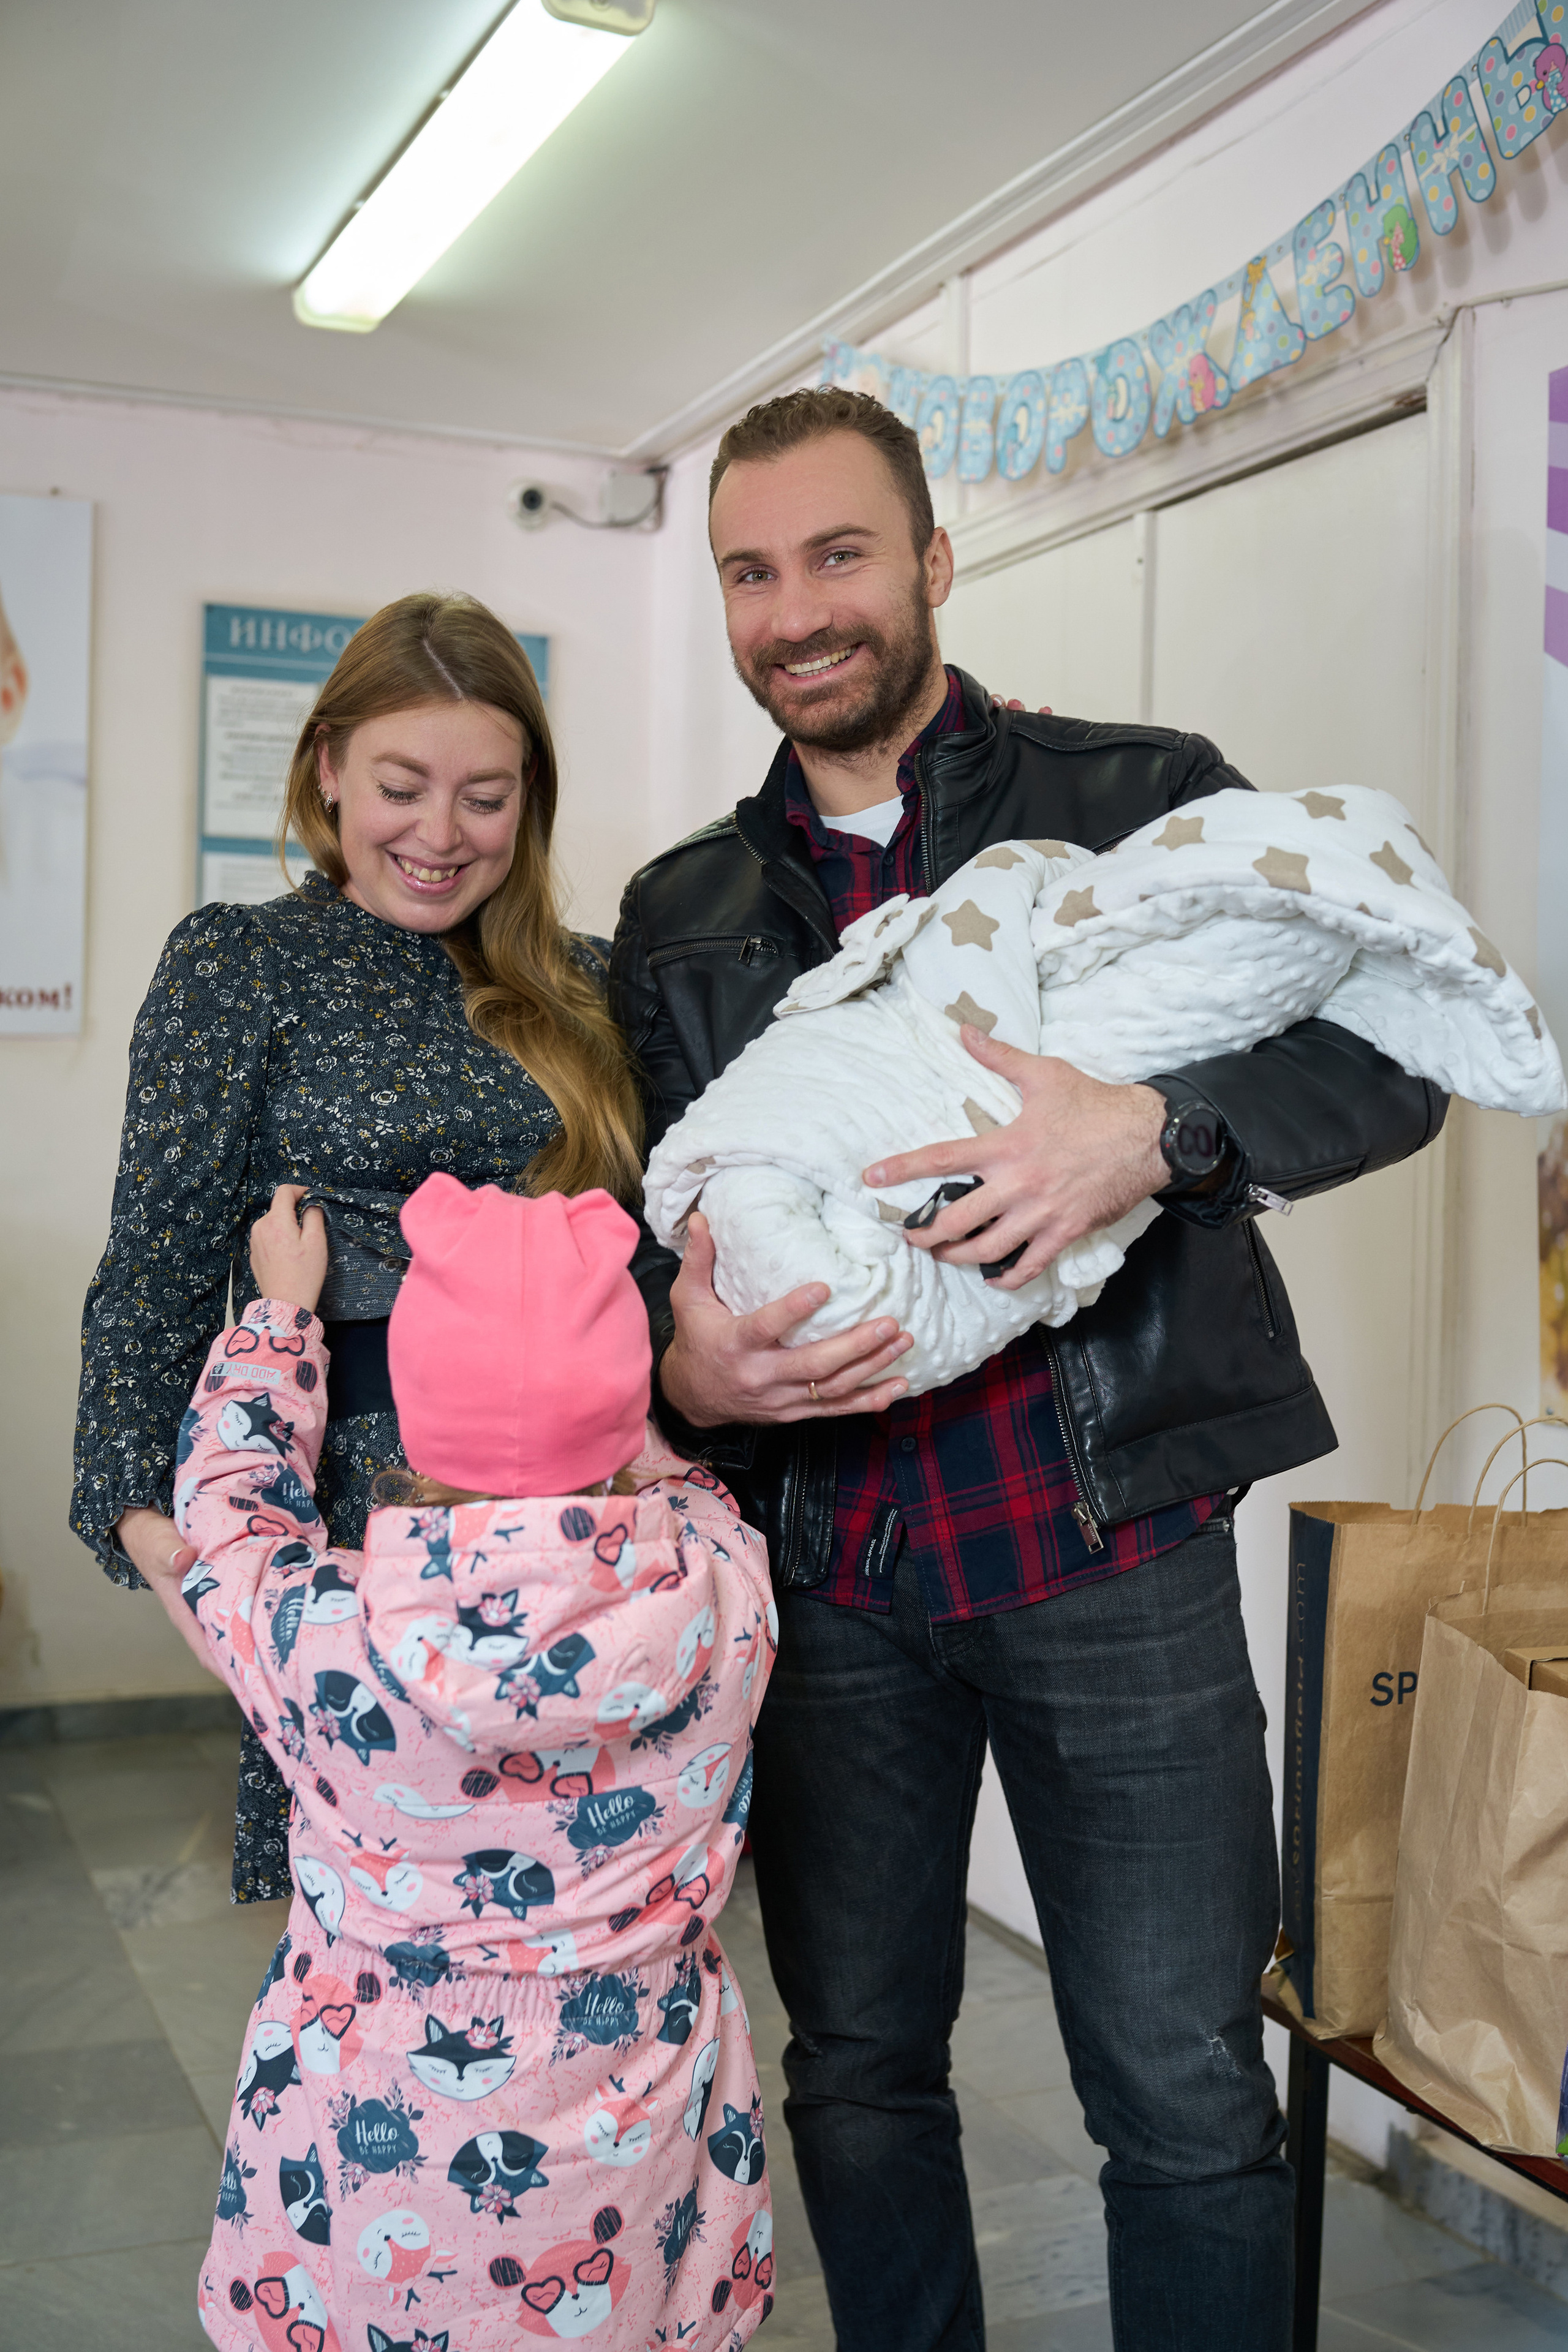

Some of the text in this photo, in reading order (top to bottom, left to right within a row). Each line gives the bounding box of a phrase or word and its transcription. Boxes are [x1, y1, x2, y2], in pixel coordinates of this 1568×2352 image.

[226, 1364, 277, 1379] ADD DRY
[587, 1794, 635, 1828] Hello
[584, 1992, 624, 2016] Hello
[355, 2119, 399, 2146] Hello
[372, 2144, 396, 2155] HAPPY
